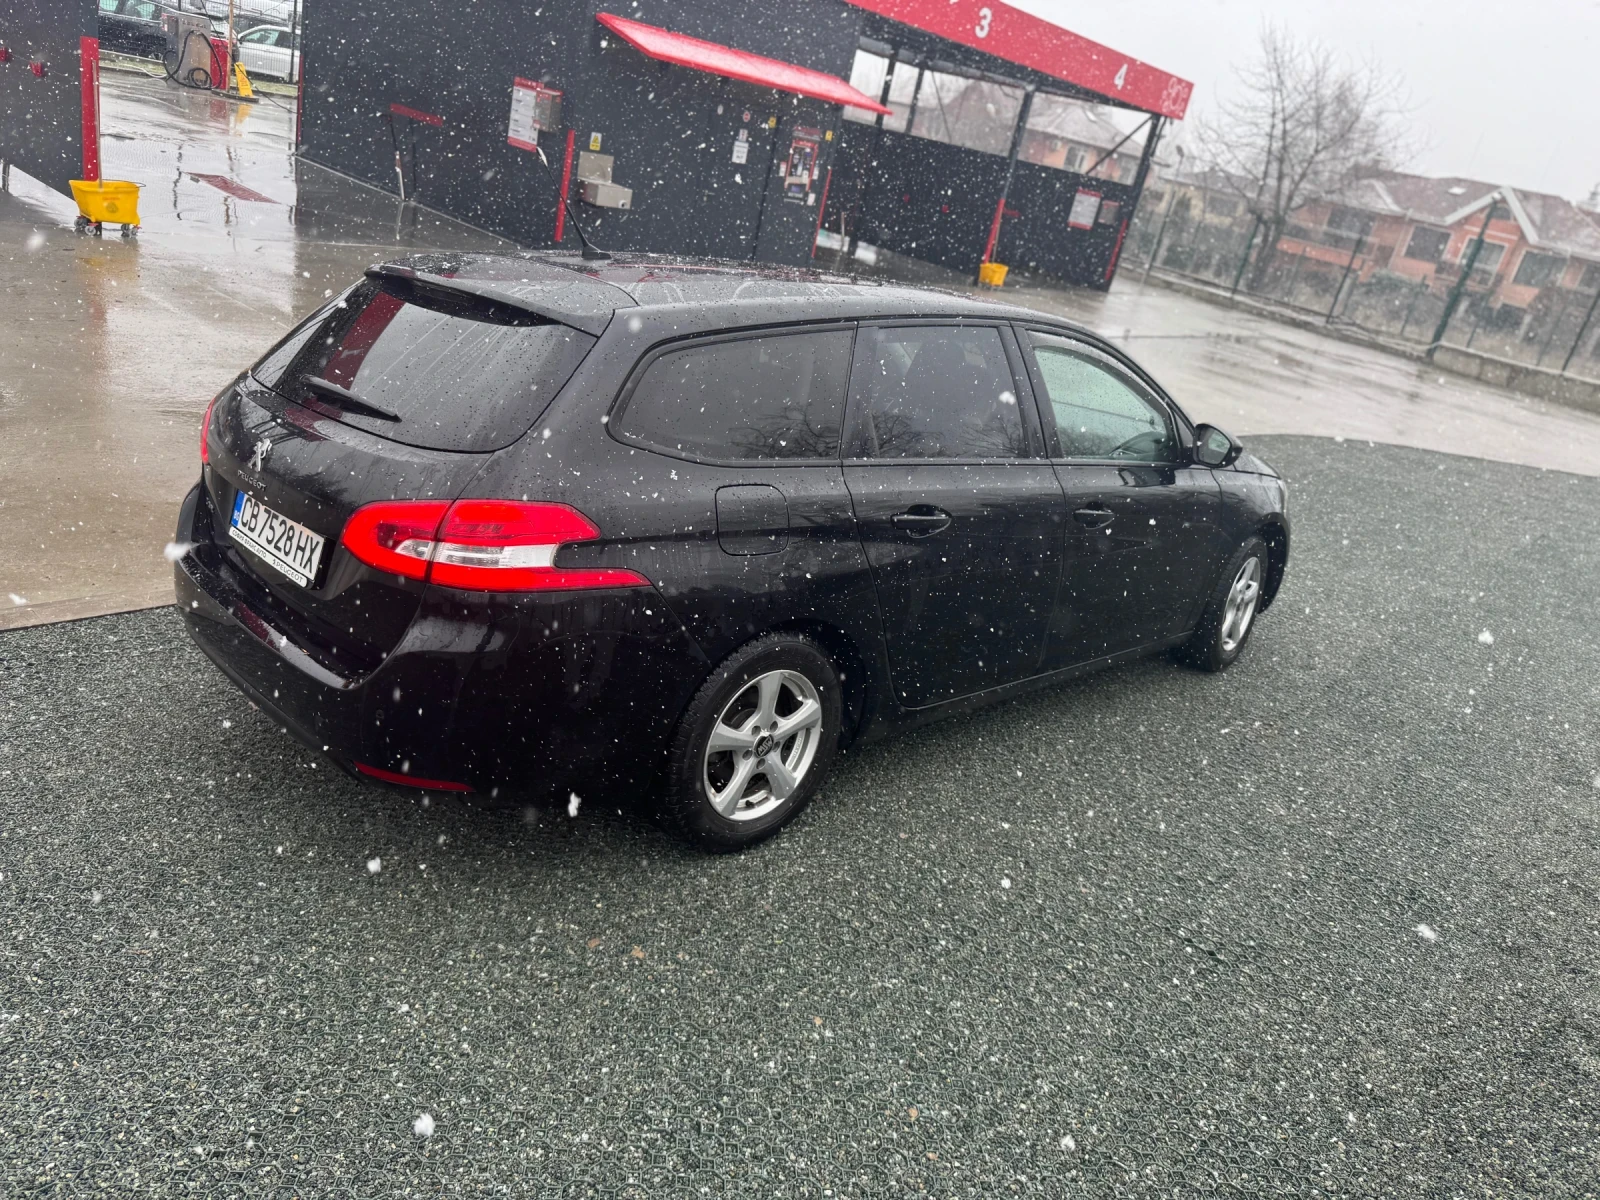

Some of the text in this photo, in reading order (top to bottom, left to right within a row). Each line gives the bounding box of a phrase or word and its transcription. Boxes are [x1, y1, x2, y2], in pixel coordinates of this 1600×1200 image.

[975, 7, 992, 38] 3
[1113, 64, 1128, 90] 4
[237, 469, 267, 491] PEUGEOT
[275, 562, 304, 583] PEUGEOT
